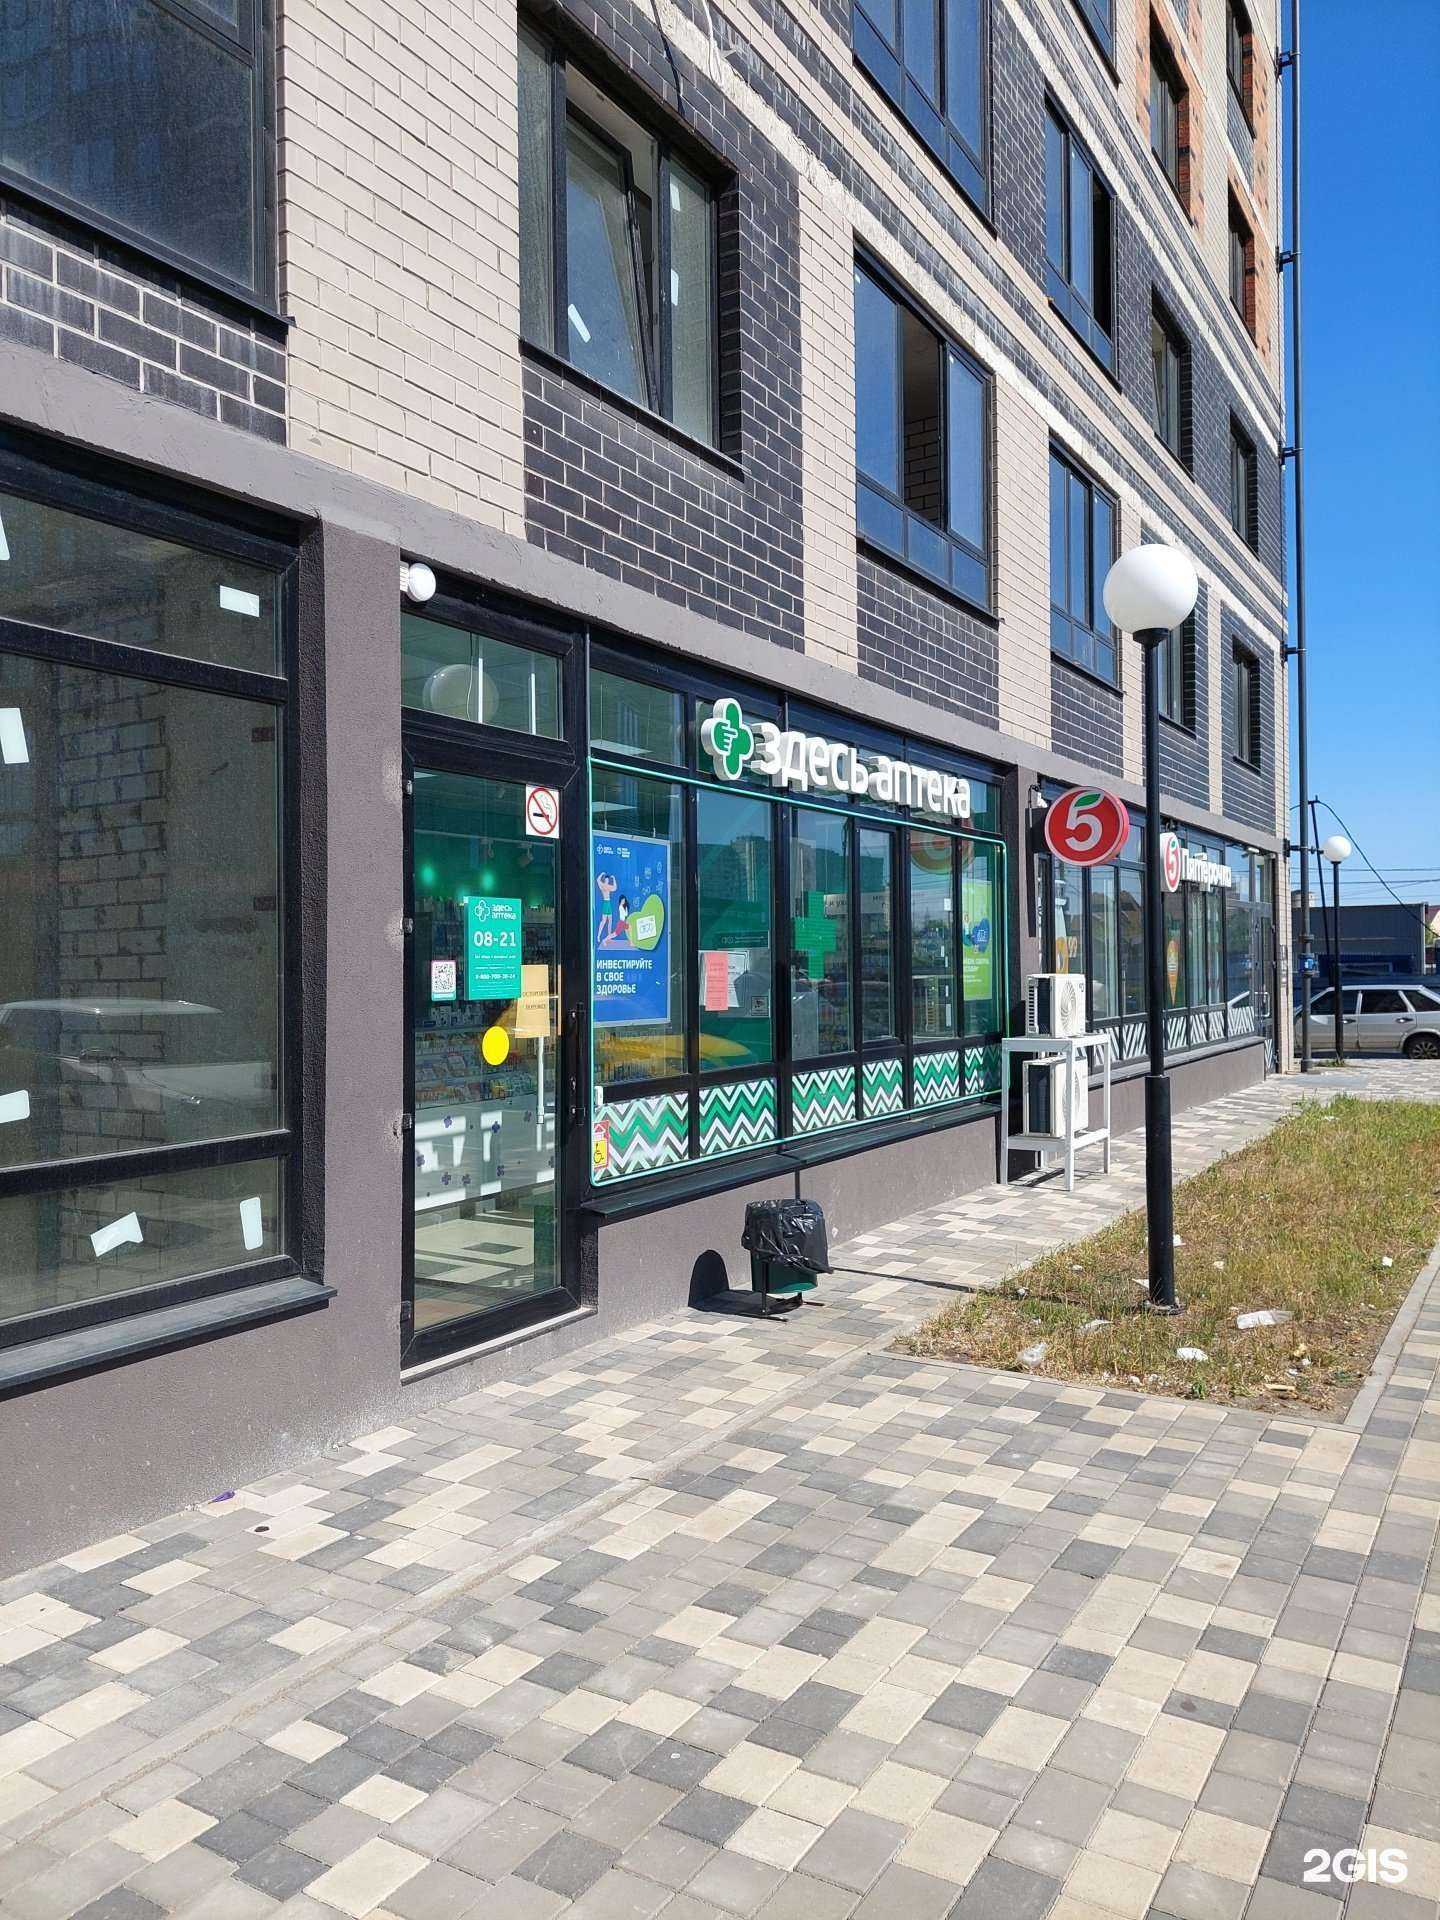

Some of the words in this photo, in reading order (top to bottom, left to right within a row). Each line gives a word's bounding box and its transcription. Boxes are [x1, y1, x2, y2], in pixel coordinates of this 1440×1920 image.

[750, 721, 869, 794] здесь
[868, 755, 971, 819] аптека
[1065, 791, 1104, 851] 5
[473, 930, 517, 947] 08-21
[596, 958, 653, 969] ИНВЕСТИРУЙТЕ
[596, 972, 602, 982] В
[603, 972, 624, 982] СВОЕ
[596, 984, 637, 996] ЗДОРОВЬЕ
